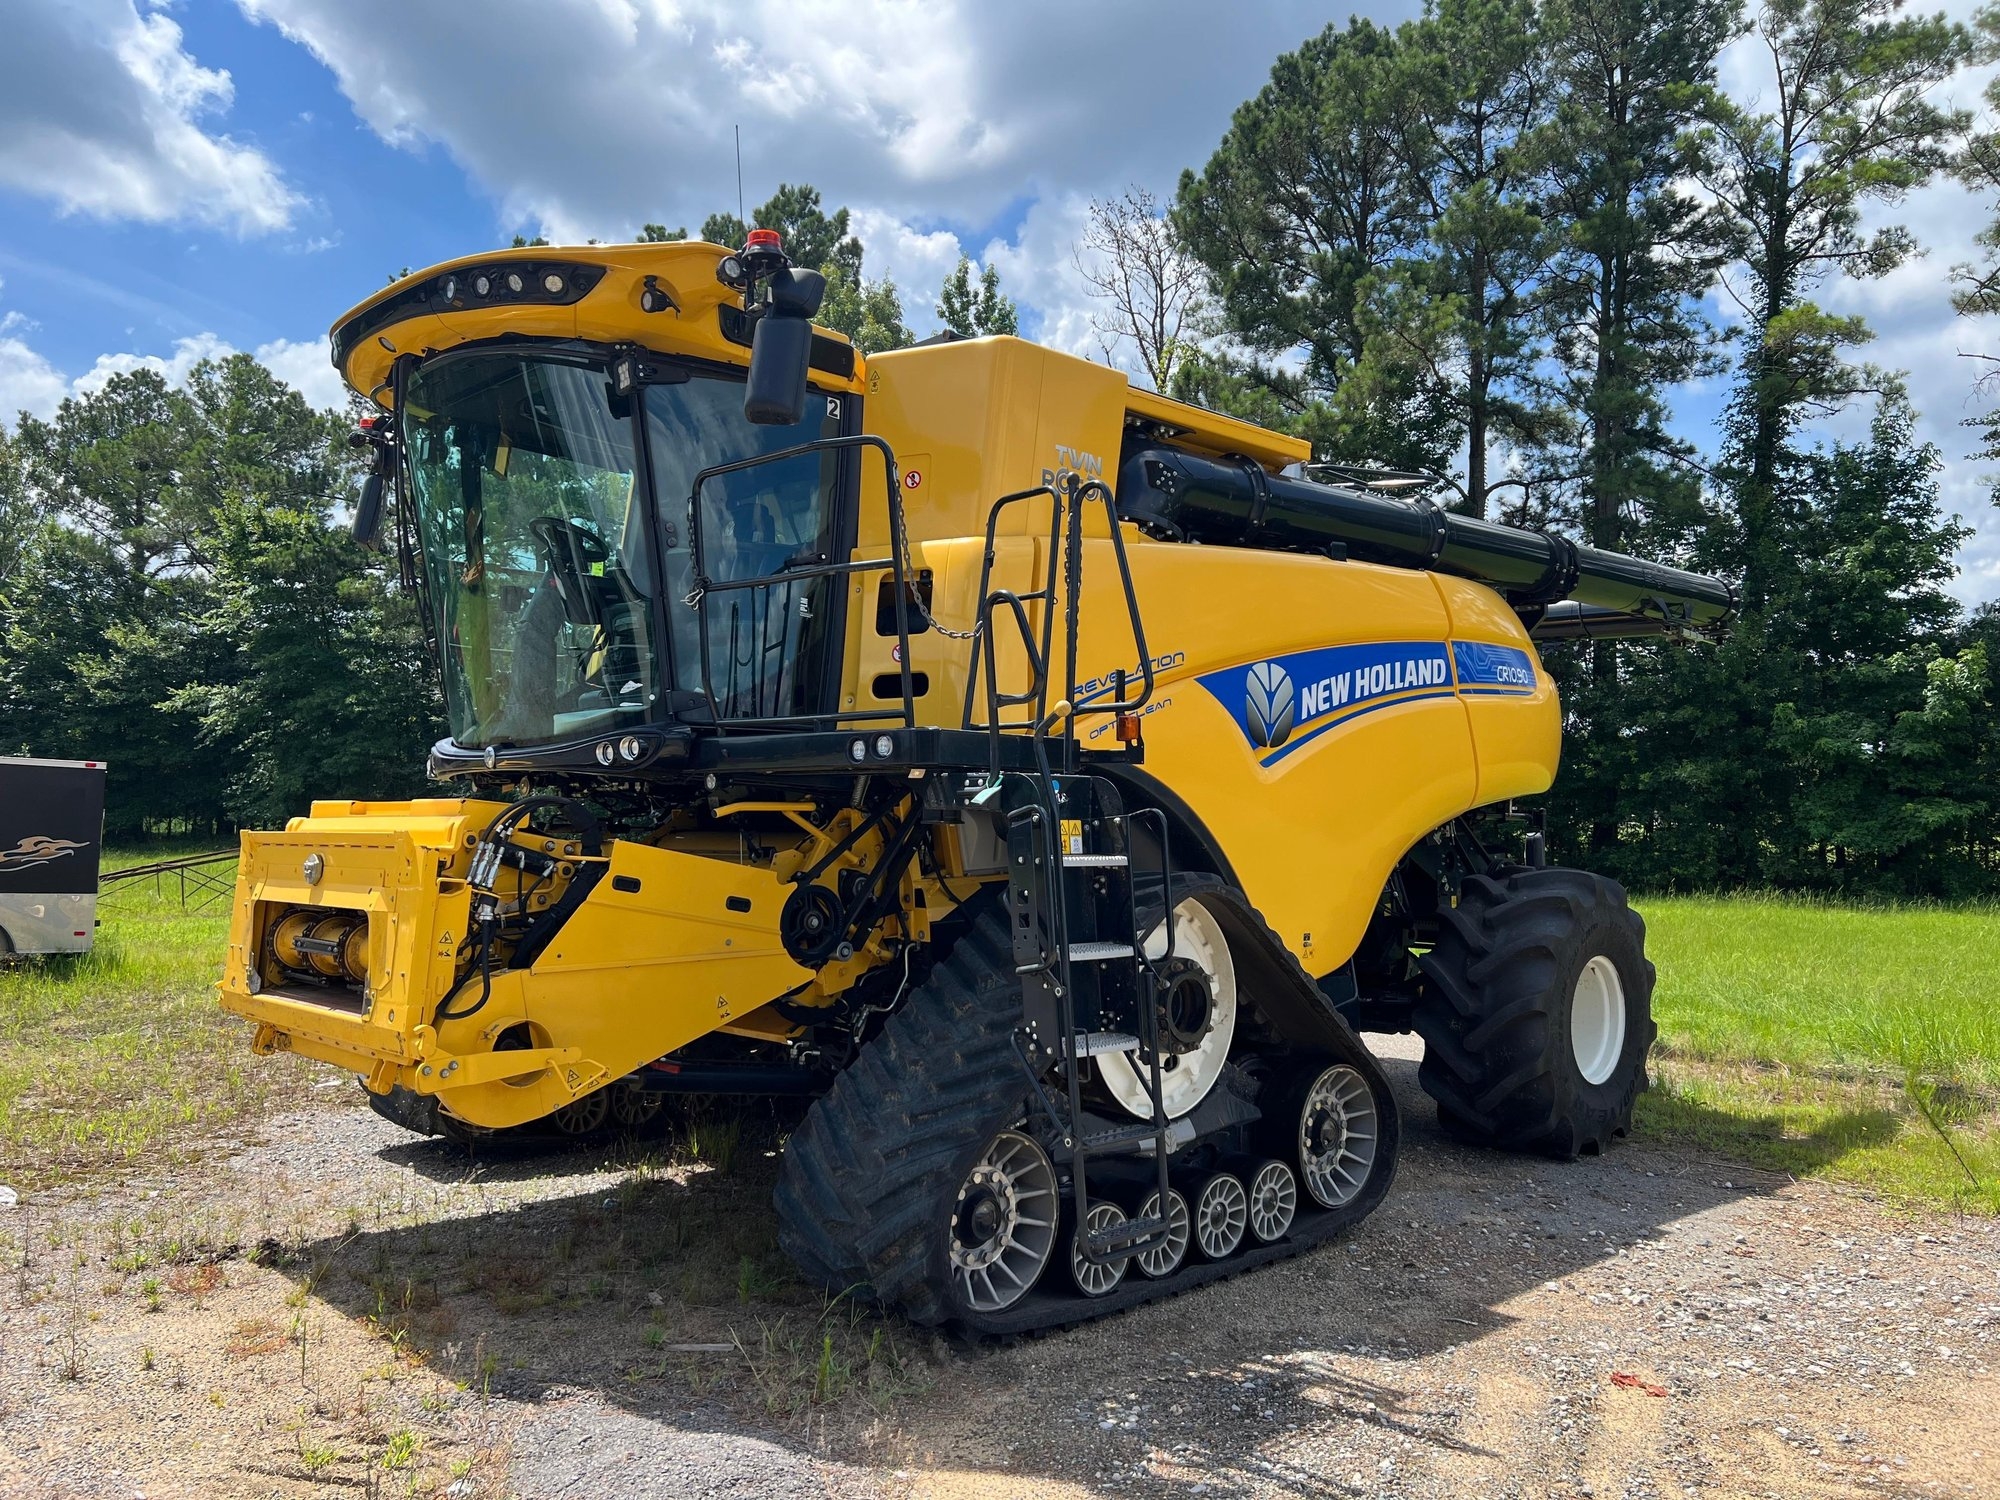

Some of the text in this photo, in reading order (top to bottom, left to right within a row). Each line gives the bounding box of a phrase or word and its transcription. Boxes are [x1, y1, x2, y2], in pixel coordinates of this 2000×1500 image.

[828, 399, 839, 418] 2
[1055, 444, 1103, 476] TWIN
[1301, 658, 1447, 720] NEW HOLLAND
[1496, 665, 1529, 684] CR10.90
[1089, 698, 1172, 740] OPTLEAN
